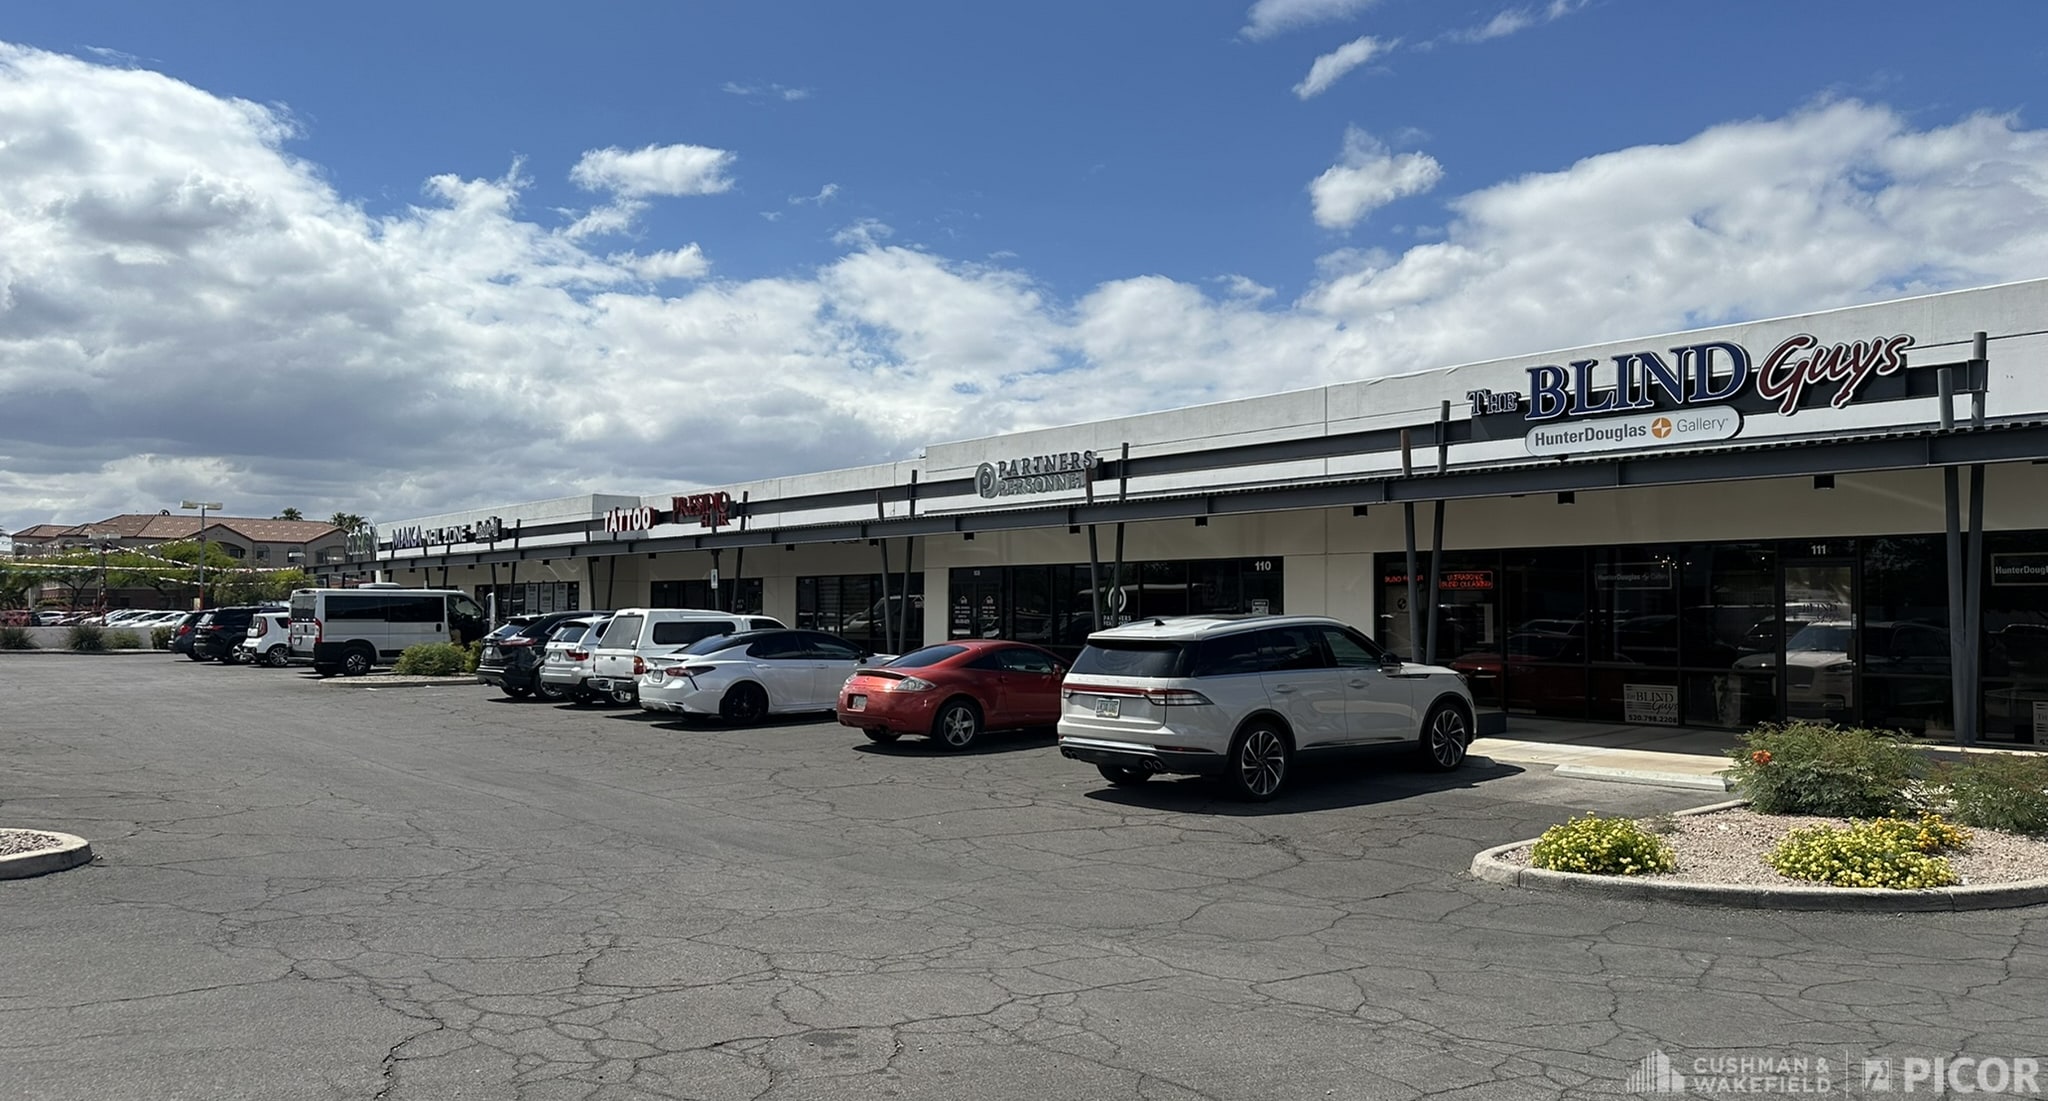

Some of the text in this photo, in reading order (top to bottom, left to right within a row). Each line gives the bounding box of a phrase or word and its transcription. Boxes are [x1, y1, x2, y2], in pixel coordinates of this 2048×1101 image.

[1525, 341, 1748, 421] BLIND
[1756, 335, 1913, 416] Guys
[1535, 424, 1647, 447] HunterDouglas
[998, 450, 1096, 479] PARTNERS
[998, 472, 1087, 497] PERSONNEL
[603, 507, 654, 533] TATTOO
[392, 525, 423, 550] MAKA
[442, 526, 468, 544] ZONE
[1811, 545, 1827, 555] 111
[1254, 560, 1272, 571] 110
[1636, 691, 1674, 703] BLIND
